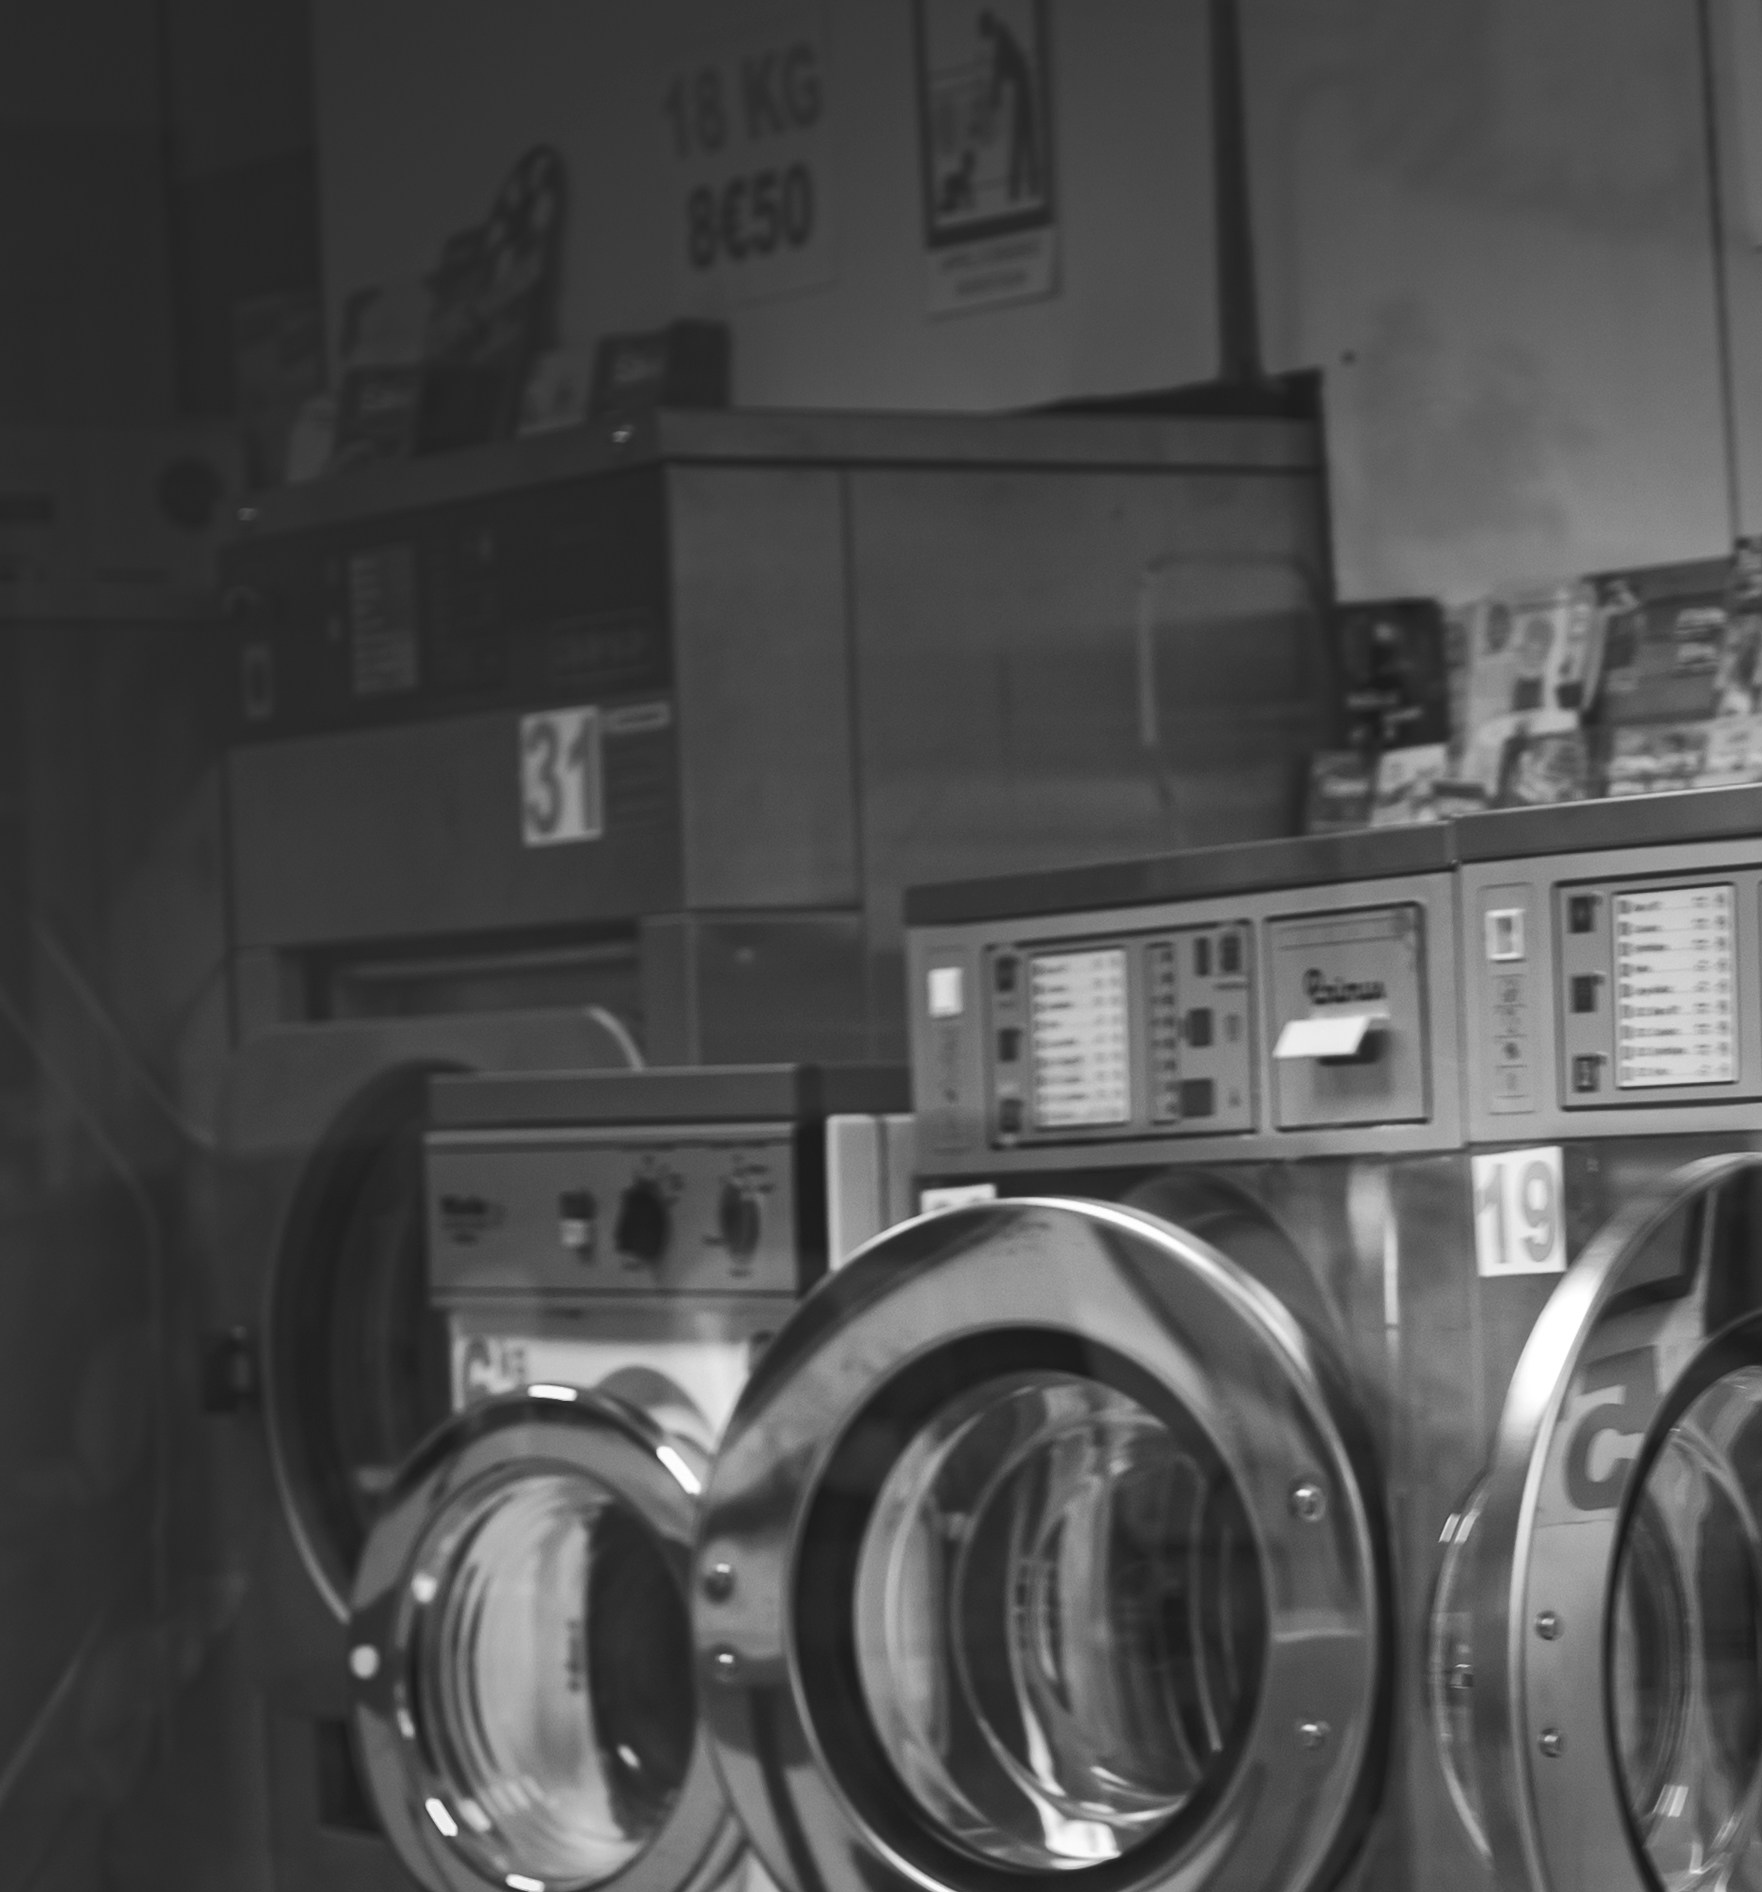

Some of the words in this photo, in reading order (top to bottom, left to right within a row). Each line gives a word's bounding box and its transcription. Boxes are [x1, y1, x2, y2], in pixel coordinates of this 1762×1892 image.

[665, 66, 727, 158] 18
[740, 41, 822, 139] KG
[688, 160, 814, 270] 8€50
[524, 717, 600, 834] 31
[1475, 1159, 1556, 1263] 19
